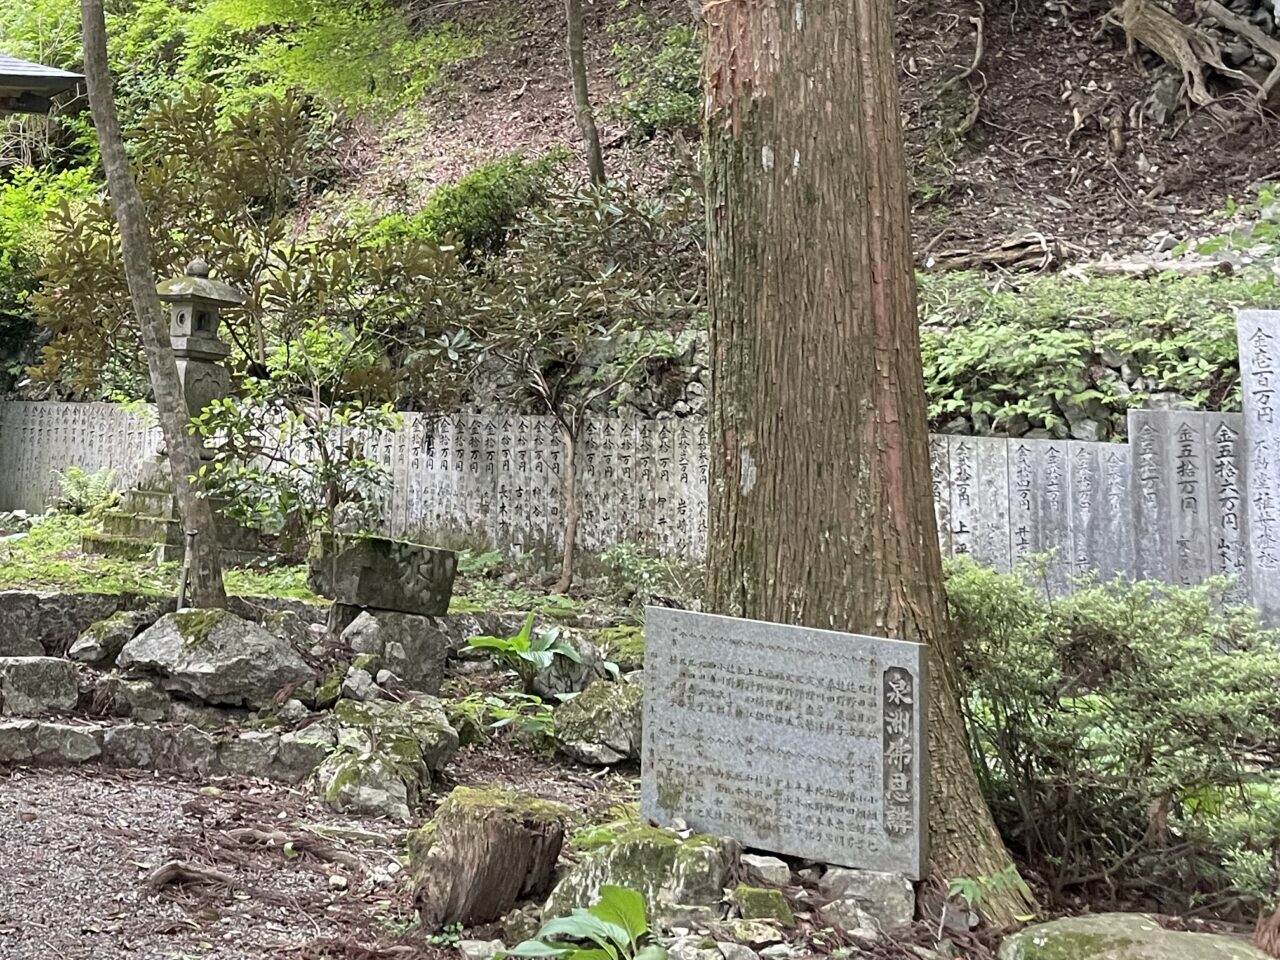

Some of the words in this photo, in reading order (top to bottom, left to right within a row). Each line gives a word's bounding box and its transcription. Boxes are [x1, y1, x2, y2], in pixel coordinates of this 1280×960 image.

[1174, 422, 1200, 514] 金五拾万円
[1212, 421, 1240, 530] 金五拾六万円
